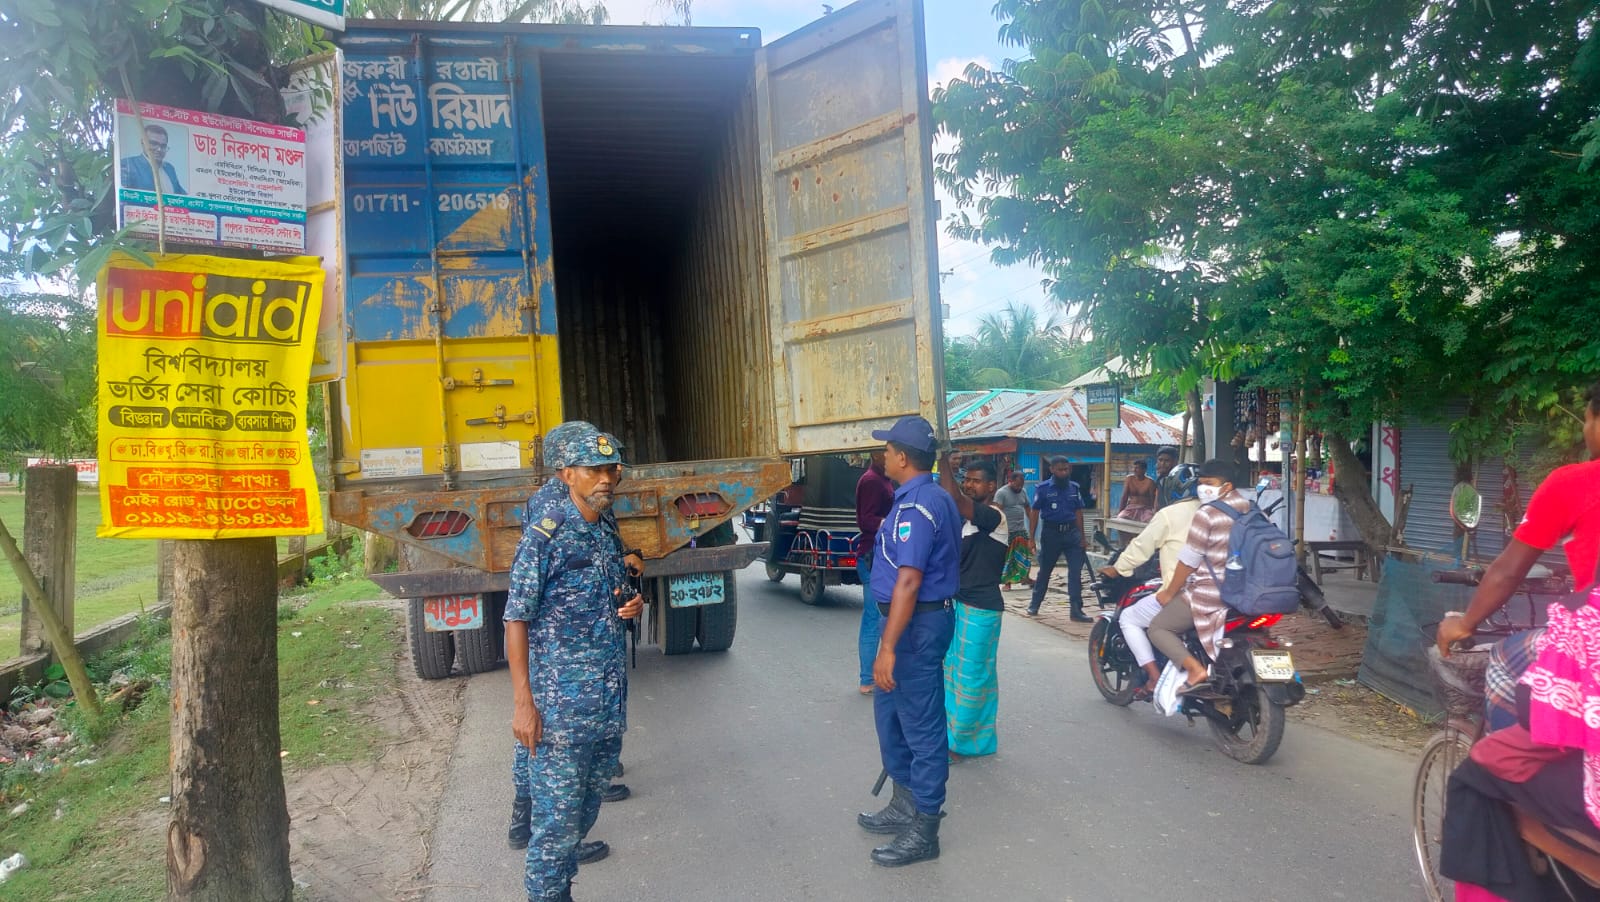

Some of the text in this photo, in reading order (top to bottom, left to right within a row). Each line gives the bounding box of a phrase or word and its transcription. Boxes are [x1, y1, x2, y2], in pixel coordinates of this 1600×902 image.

[193, 134, 217, 156] ডাঃ
[221, 133, 271, 164] নিরুপম
[438, 192, 510, 213] 206519
[112, 274, 308, 342] uniaid
[143, 347, 269, 378] বিশ্ববিদ্যালয়
[107, 375, 297, 408] ভর্তির সেরা কোচিং
[120, 408, 163, 427] বিজ্ঞান
[177, 409, 227, 428] মানবিক
[139, 468, 224, 490] দৌলতপুর
